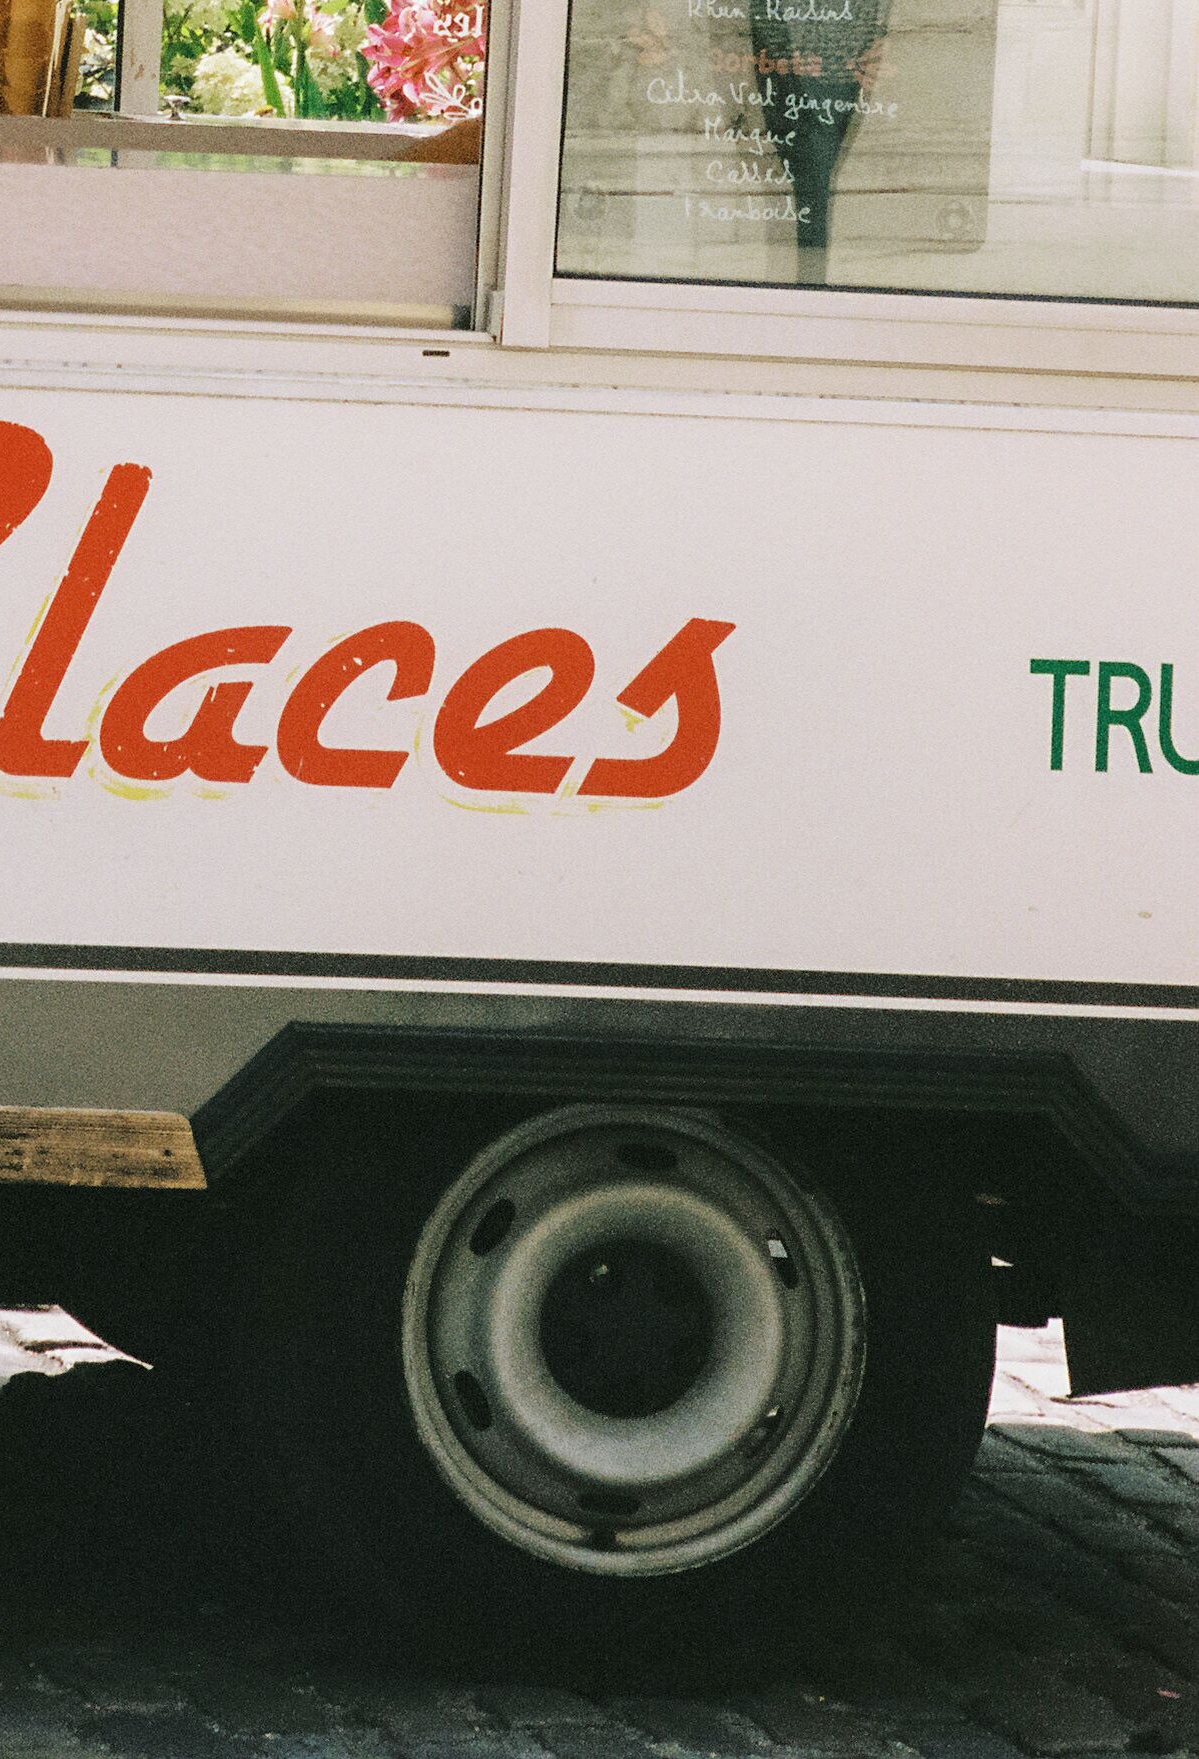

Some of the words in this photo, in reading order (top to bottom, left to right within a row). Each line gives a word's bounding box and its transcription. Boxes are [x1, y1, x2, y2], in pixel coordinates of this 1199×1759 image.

[646, 68, 727, 105] Citron
[730, 78, 777, 107] Vert
[783, 87, 899, 125] gingembre
[704, 116, 797, 156] Mangue
[706, 159, 796, 185] Cassis
